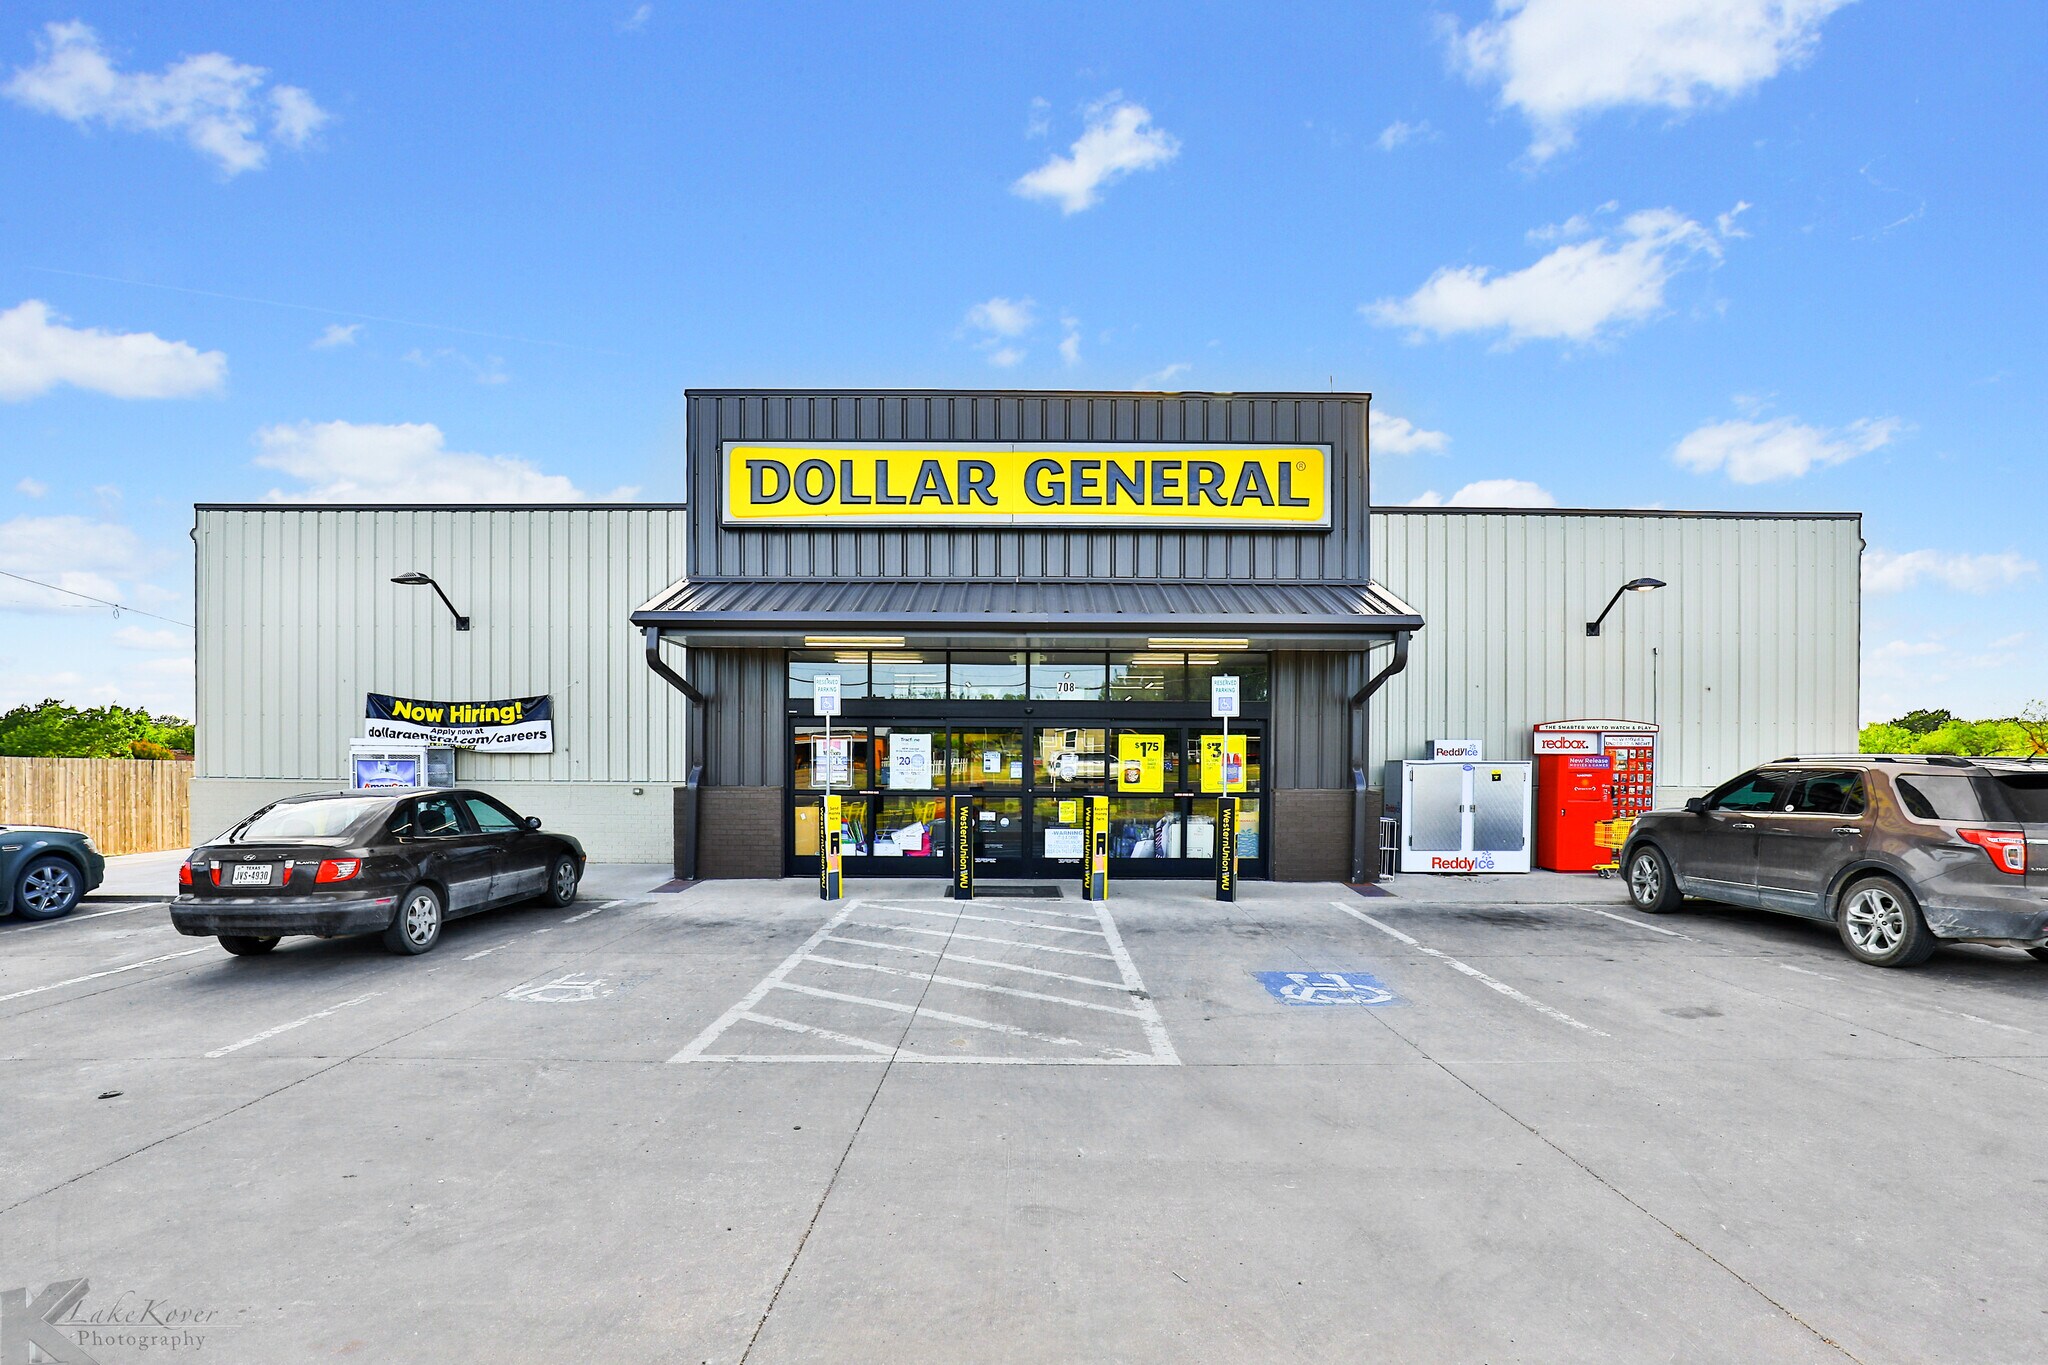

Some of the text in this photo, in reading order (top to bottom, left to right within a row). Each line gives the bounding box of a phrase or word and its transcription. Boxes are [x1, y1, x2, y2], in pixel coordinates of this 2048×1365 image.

[745, 458, 1311, 507] DOLLAR GENERAL
[1057, 682, 1075, 692] 708
[391, 700, 523, 724] Now Hiring!
[431, 728, 456, 736] Apply
[1206, 742, 1222, 758] $3
